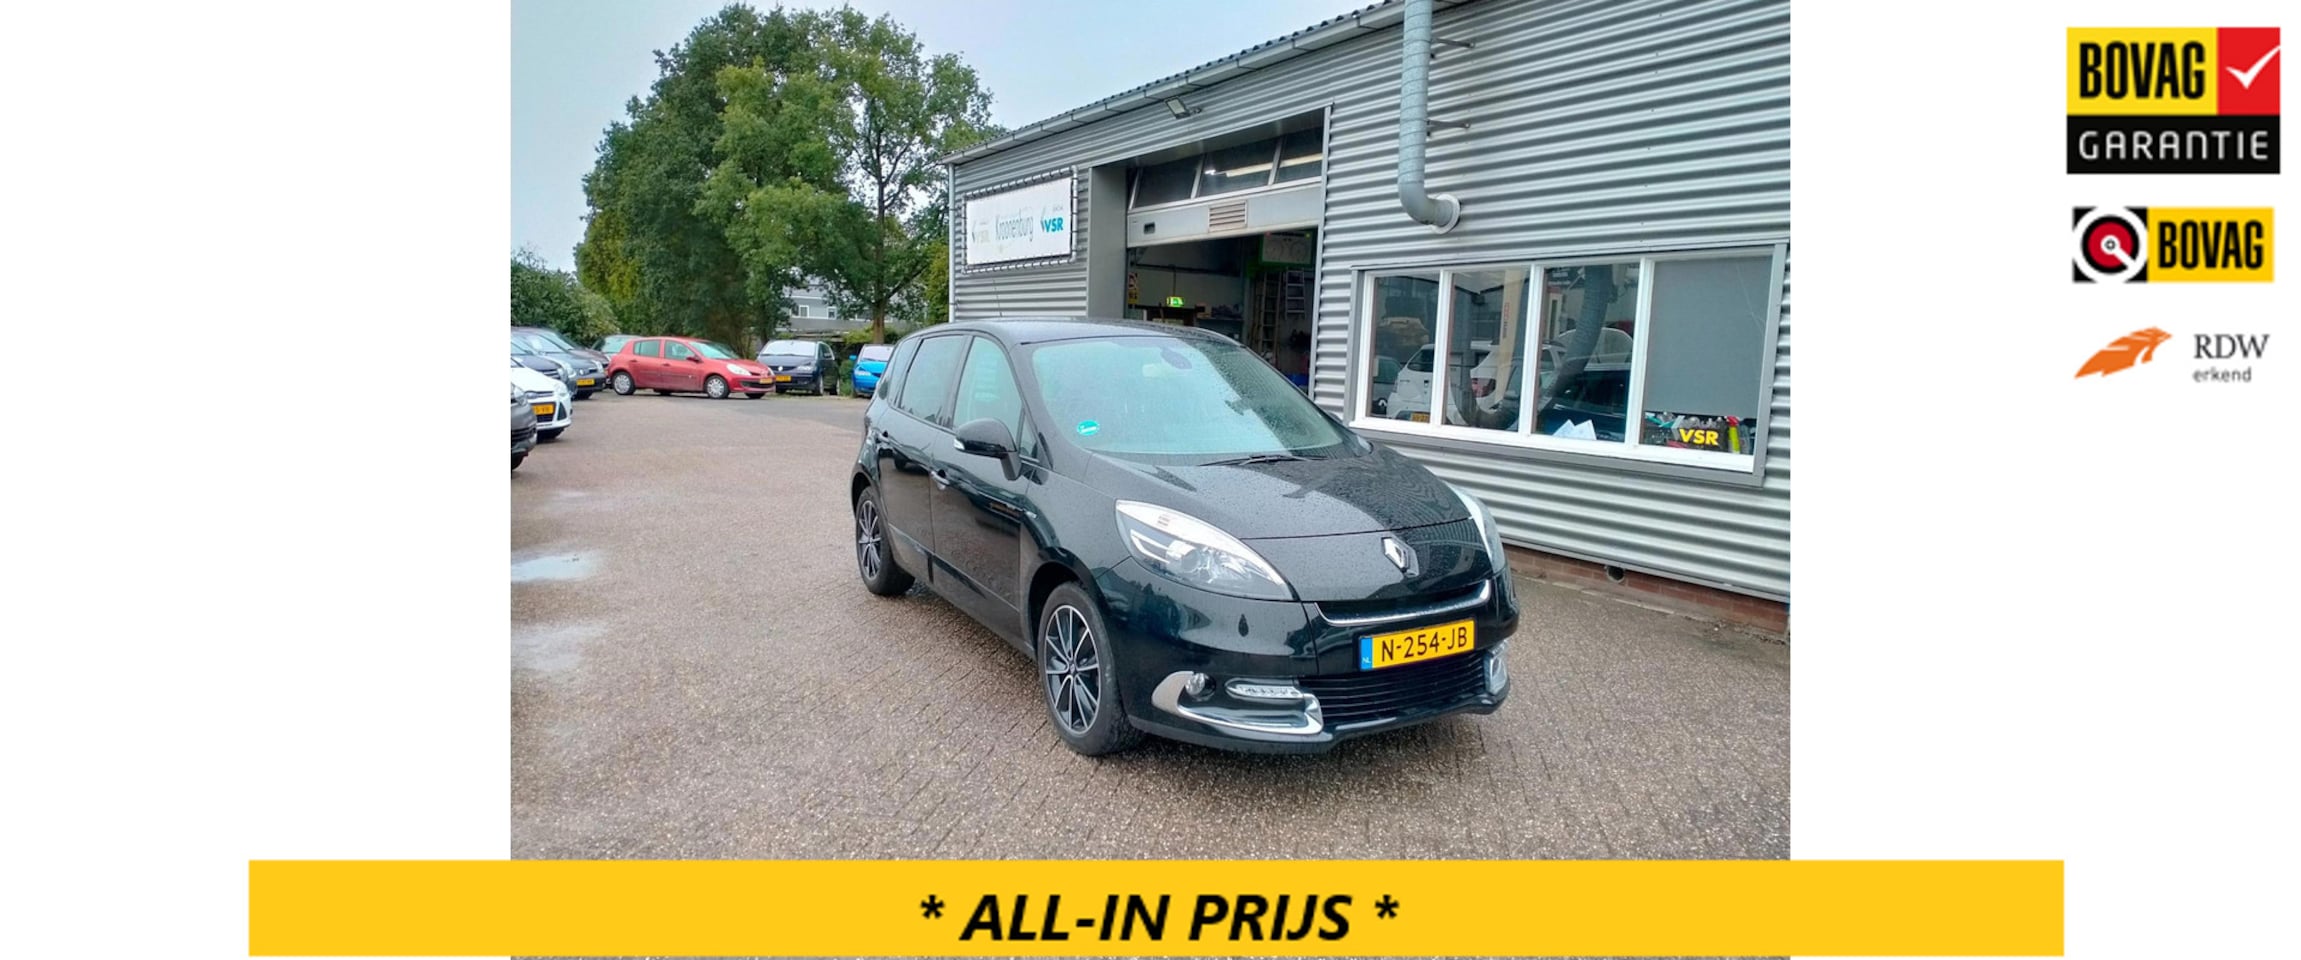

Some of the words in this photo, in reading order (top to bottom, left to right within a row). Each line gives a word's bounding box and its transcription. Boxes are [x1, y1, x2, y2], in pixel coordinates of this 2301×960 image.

[1044, 217, 1064, 233] VSR
[1679, 428, 1719, 446] VSR
[1381, 625, 1468, 662] N-254-JB
